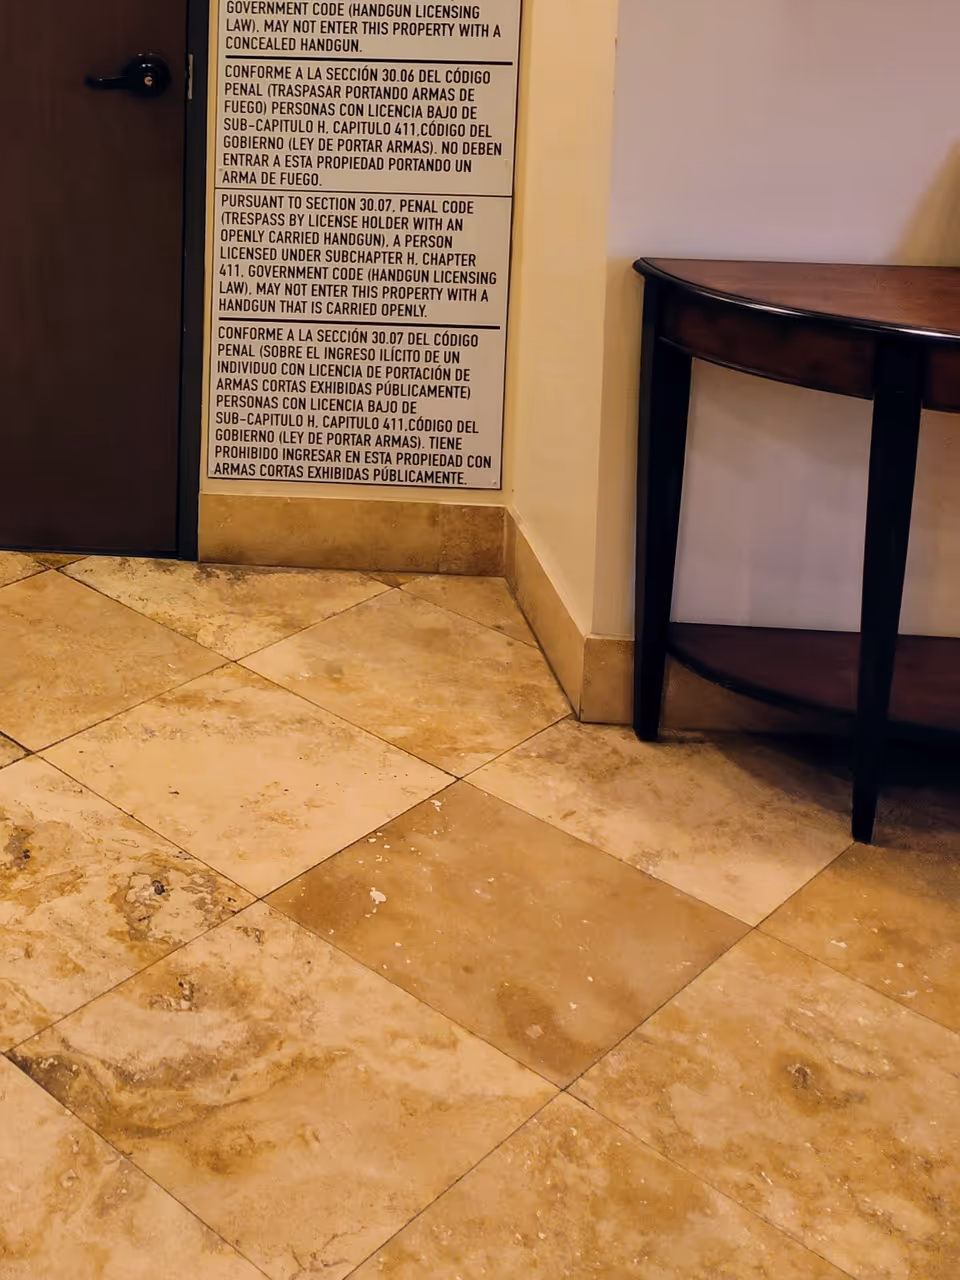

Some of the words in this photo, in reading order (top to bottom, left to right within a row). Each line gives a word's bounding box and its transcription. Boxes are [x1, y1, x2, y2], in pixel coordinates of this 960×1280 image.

[227, 0, 309, 15] GOVERNMENT
[313, 2, 344, 16] CODE
[349, 3, 411, 17] (HANDGUN
[416, 5, 480, 19] LICENSING
[264, 19, 289, 33] MAY
[293, 20, 317, 33] NOT
[320, 20, 358, 34] ENTER
[362, 21, 388, 35] THIS
[393, 22, 455, 37] PROPERTY
[459, 24, 489, 38] WITH
[493, 24, 501, 38] A
[226, 36, 296, 51] CONCEALED
[301, 38, 362, 52] HANDGUN.
[225, 65, 291, 79] CONFORME
[295, 67, 303, 80] A
[307, 67, 322, 80] LA
[326, 67, 378, 81] SECCIÓN
[382, 69, 414, 82] 30.06
[419, 69, 441, 83] DEL
[445, 69, 491, 84] CÓDIGO
[225, 82, 263, 97] PENAL
[267, 83, 341, 98] (TRASPASAR
[345, 85, 408, 100] PORTANDO
[412, 87, 455, 101] ARMAS
[459, 88, 475, 102] DE
[224, 100, 267, 115] FUEGO)
[272, 101, 335, 116] PERSONAS
[340, 103, 364, 117] CON
[368, 104, 423, 118] LICENCIA
[427, 105, 457, 119] BAJO
[462, 106, 477, 120] DE
[223, 135, 284, 150] GOBIERNO
[289, 137, 314, 151] (LEY
[318, 138, 333, 151] DE
[338, 139, 383, 152] PORTAR
[442, 141, 458, 155] NO
[462, 142, 502, 156] DEBEN
[223, 153, 269, 167] ENTRAR
[273, 155, 281, 167] A
[285, 155, 313, 168] ESTA
[317, 156, 384, 170] PROPIEDAD
[388, 158, 451, 172] PORTANDO
[455, 160, 472, 173] UN
[222, 172, 257, 184] ARMA
[261, 172, 276, 185] DE
[280, 172, 322, 186] FUEGO.
[221, 194, 284, 208] PURSUANT
[288, 196, 302, 209] TO
[306, 196, 356, 211] SECTION
[400, 199, 438, 213] PENAL
[442, 200, 474, 214] CODE
[221, 211, 285, 226] (TRESPASS
[289, 214, 305, 227] BY
[309, 214, 358, 228] LICENSE
[362, 216, 409, 230] HOLDER
[413, 217, 443, 231] WITH
[446, 218, 463, 231] AN
[256, 282, 281, 295] MAY
[285, 283, 307, 296] NOT
[311, 284, 348, 297] ENTER
[352, 285, 378, 299] THIS
[382, 286, 443, 300] PROPERTY
[447, 288, 477, 302] WITH
[481, 289, 489, 303] A
[219, 298, 276, 312] HANDGUN
[280, 300, 308, 313] THAT
[311, 301, 322, 314] IS
[326, 302, 377, 316] CARRIED
[381, 304, 427, 318] OPENLY.
[218, 326, 283, 341] CONFORME
[287, 328, 295, 341] A
[299, 329, 313, 342] LA
[317, 329, 368, 343] SECCIÓN
[372, 331, 404, 345] 30.07
[408, 332, 430, 346] DEL
[434, 332, 478, 348] CÓDIGO
[218, 343, 255, 357] PENAL
[260, 345, 302, 359] (SOBRE
[306, 346, 320, 359] EL
[324, 347, 376, 361] INGRESO
[380, 347, 420, 363] ILÍCITO
[425, 350, 440, 363] DE
[444, 351, 460, 364] UN
[217, 361, 277, 375] INDIVIDUO
[281, 363, 305, 376] CON
[309, 364, 363, 378] LICENCIA
[367, 365, 382, 378] DE
[386, 366, 451, 381] PORTACIÓN
[455, 369, 470, 382] DE
[216, 377, 258, 391] ARMAS
[262, 379, 306, 393] CORTAS
[310, 381, 372, 395] EXHIBIDAS
[376, 383, 471, 400] PÚBLICAMENTE)
[216, 394, 279, 409] PERSONAS
[283, 397, 306, 410] CON
[311, 398, 364, 412] LICENCIA
[368, 400, 398, 413] BAJO
[402, 401, 417, 414] DE
[215, 428, 275, 443] GOBIERNO
[279, 431, 304, 444] (LEY
[308, 432, 323, 445] DE
[327, 432, 371, 447] PORTAR
[429, 436, 462, 450] TIENE
[215, 445, 278, 460] PROHIBIDO
[283, 448, 341, 462] INGRESAR
[345, 450, 360, 463] EN
[365, 451, 392, 464] ESTA
[396, 452, 463, 467] PROPIEDAD
[467, 455, 491, 469] CON
[214, 462, 256, 476] ARMAS
[260, 464, 304, 478] CORTAS
[308, 466, 369, 481] EXHIBIDAS
[373, 468, 467, 485] PÚBLICAMENTE.
